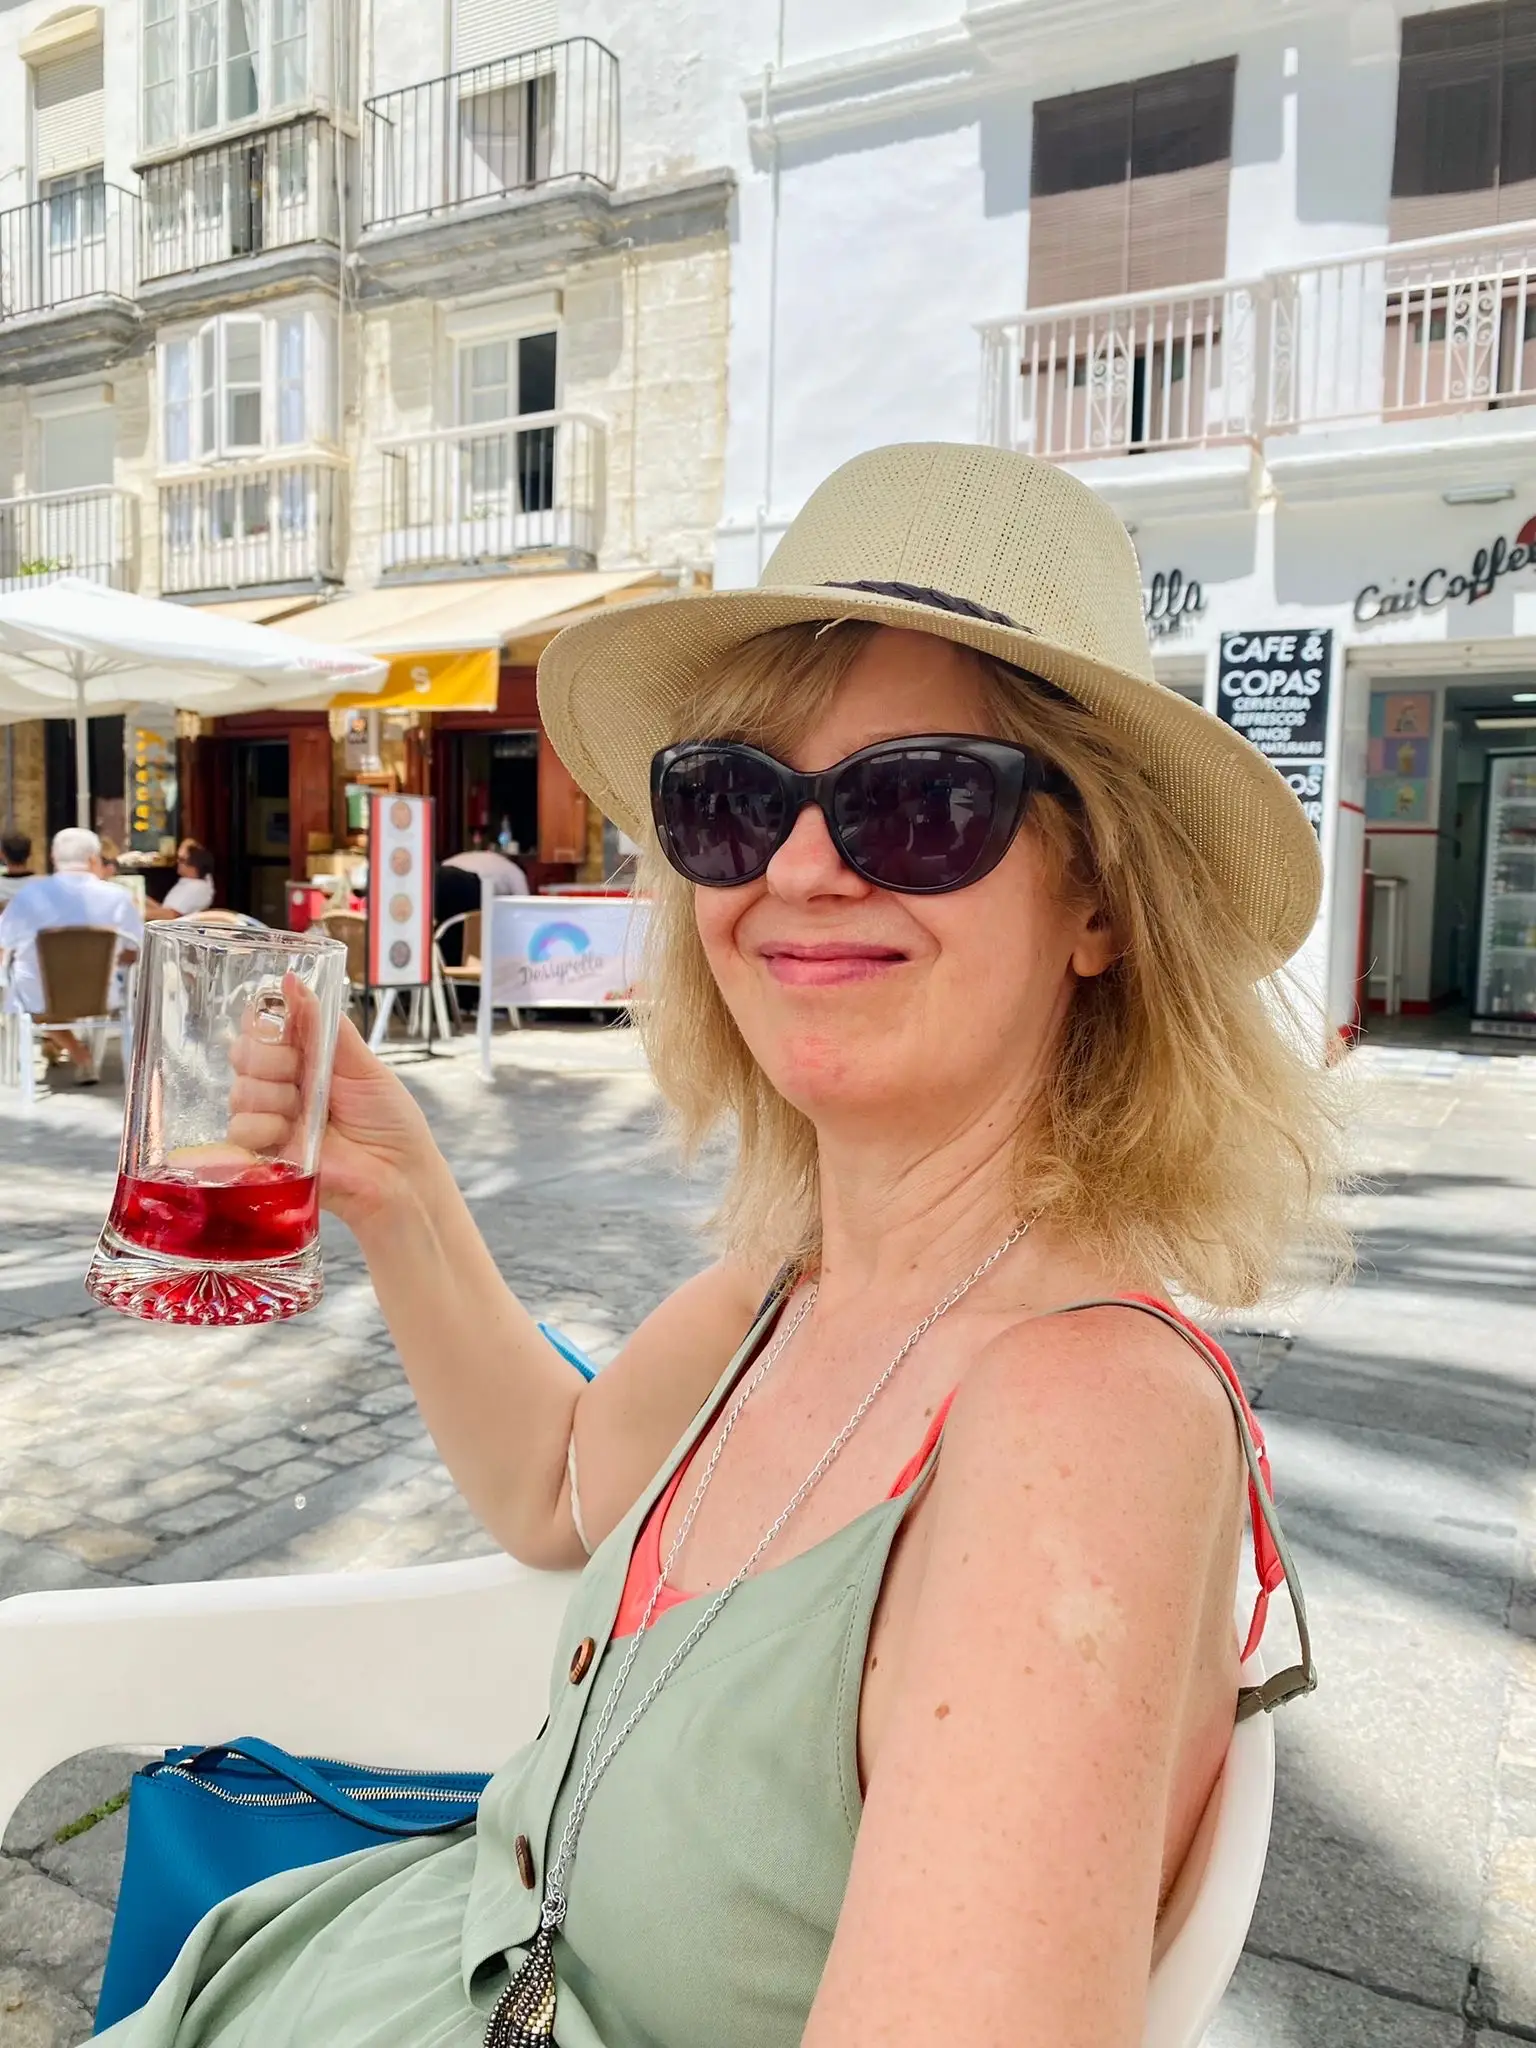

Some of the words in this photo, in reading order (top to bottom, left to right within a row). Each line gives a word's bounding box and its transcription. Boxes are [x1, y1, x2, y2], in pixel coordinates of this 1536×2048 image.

[1144, 568, 1208, 621] lla
[1222, 636, 1298, 663] CAFE
[1301, 635, 1325, 662] &
[1221, 668, 1322, 697] COPAS
[1231, 711, 1306, 727] REFRESCOS
[1246, 727, 1292, 741] VINOS
[1285, 773, 1321, 797] OS
